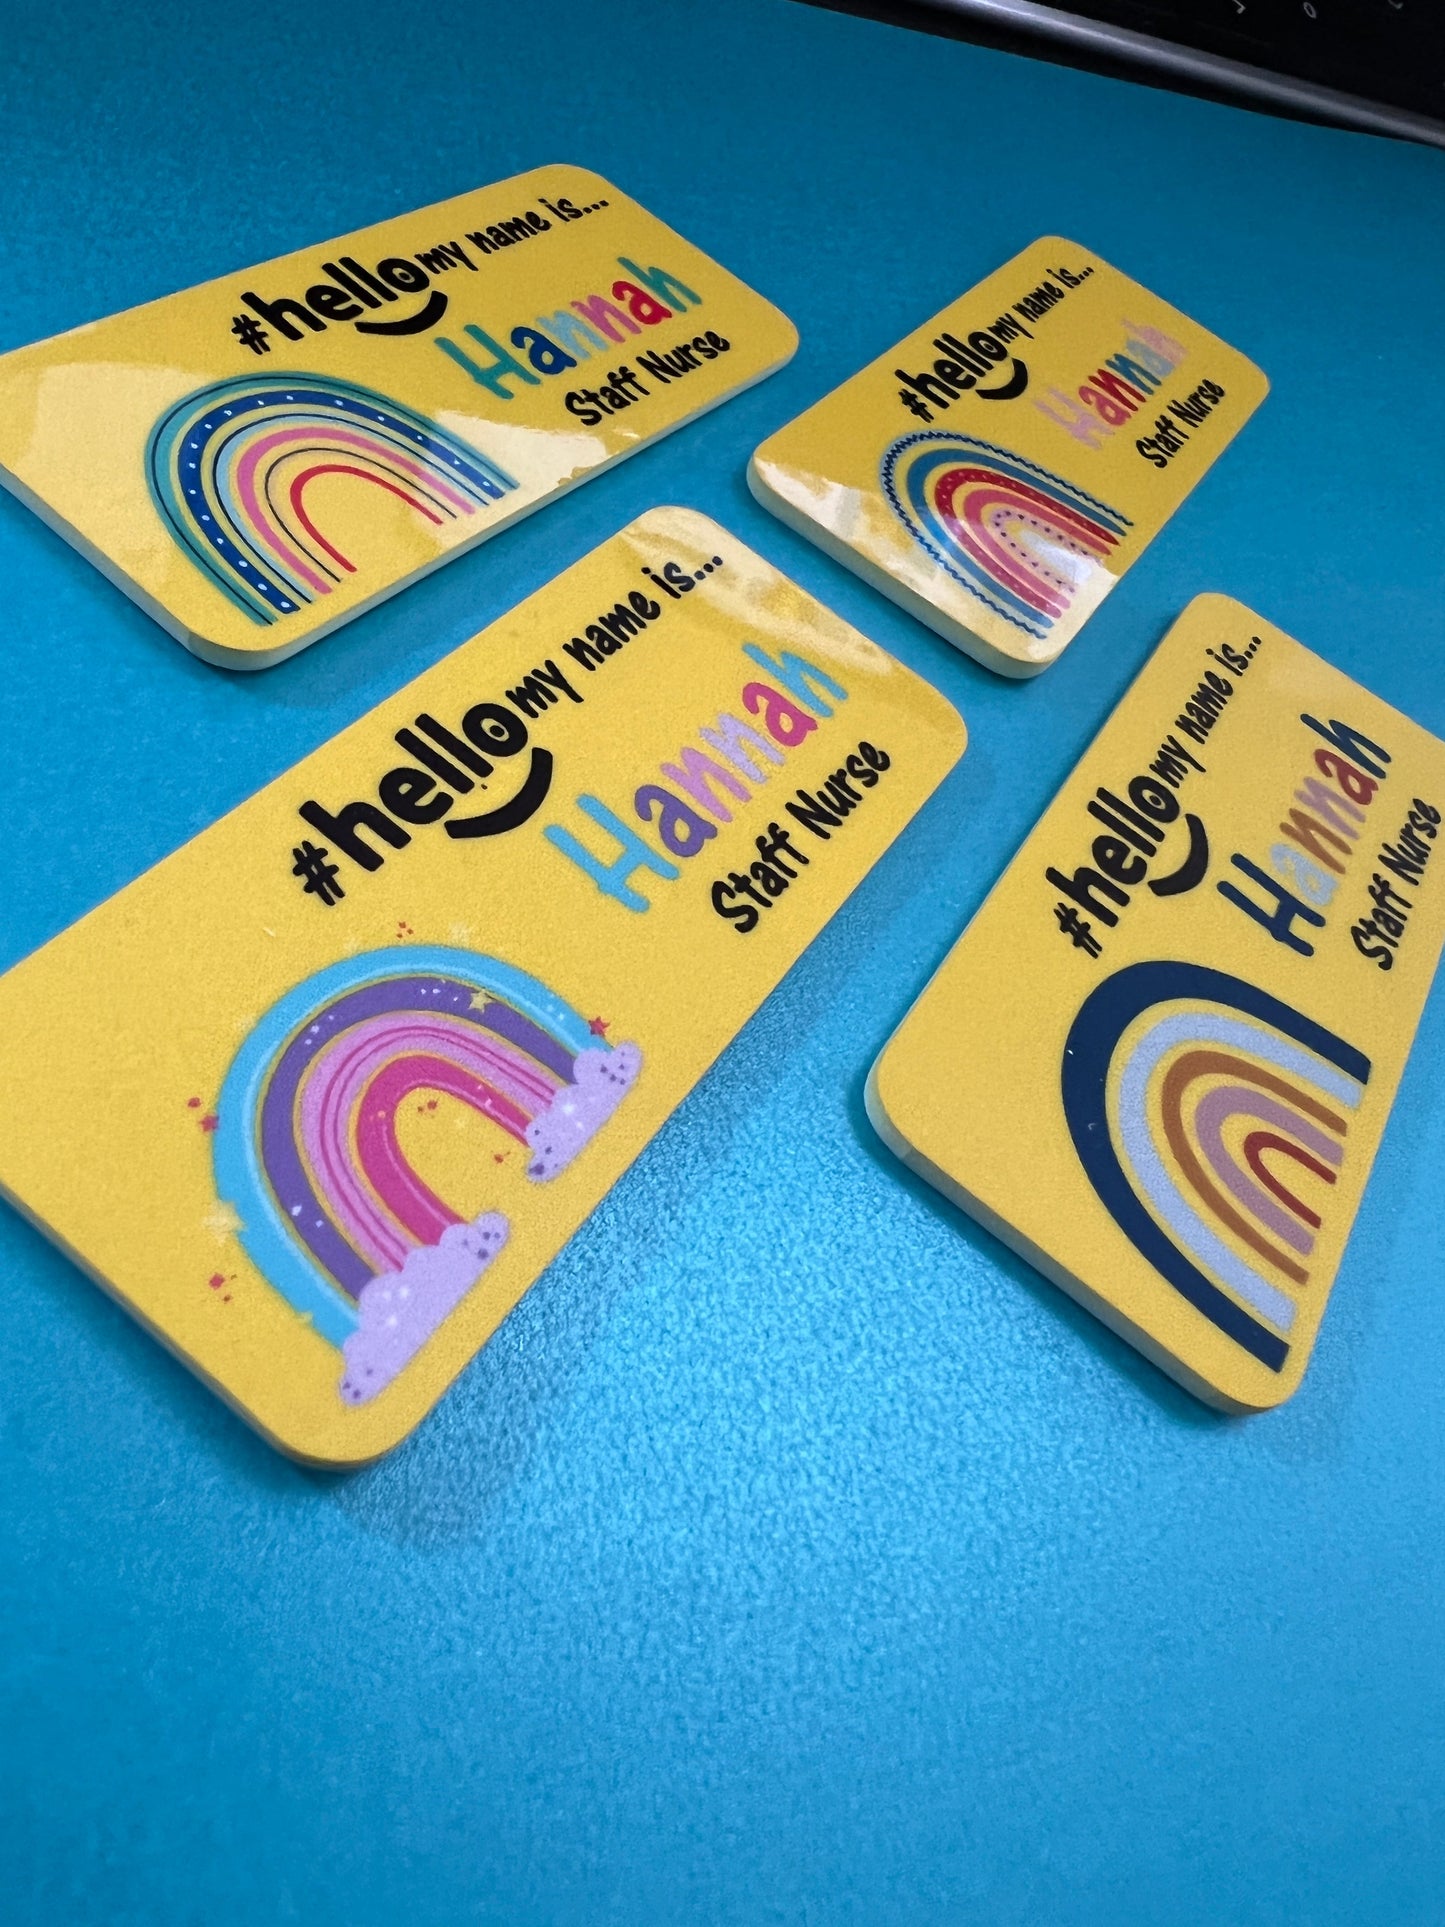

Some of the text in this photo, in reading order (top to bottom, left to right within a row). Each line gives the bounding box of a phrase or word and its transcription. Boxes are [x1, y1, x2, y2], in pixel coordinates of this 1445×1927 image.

[231, 197, 609, 354] #hello my name is...
[435, 257, 703, 400] Hannah
[894, 267, 1094, 423] #hello my name is...
[565, 330, 731, 426] Staff Nurse
[1033, 316, 1188, 450] Hannah
[1136, 378, 1225, 468] Staff Nurse
[292, 555, 723, 906] #hello my name is...
[542, 642, 849, 914] Hannah
[1045, 636, 1262, 959] #hello my name is...
[711, 741, 891, 933] Staff Nurse
[1216, 713, 1391, 957] Hannah
[1350, 798, 1442, 971] Staff Nurse
